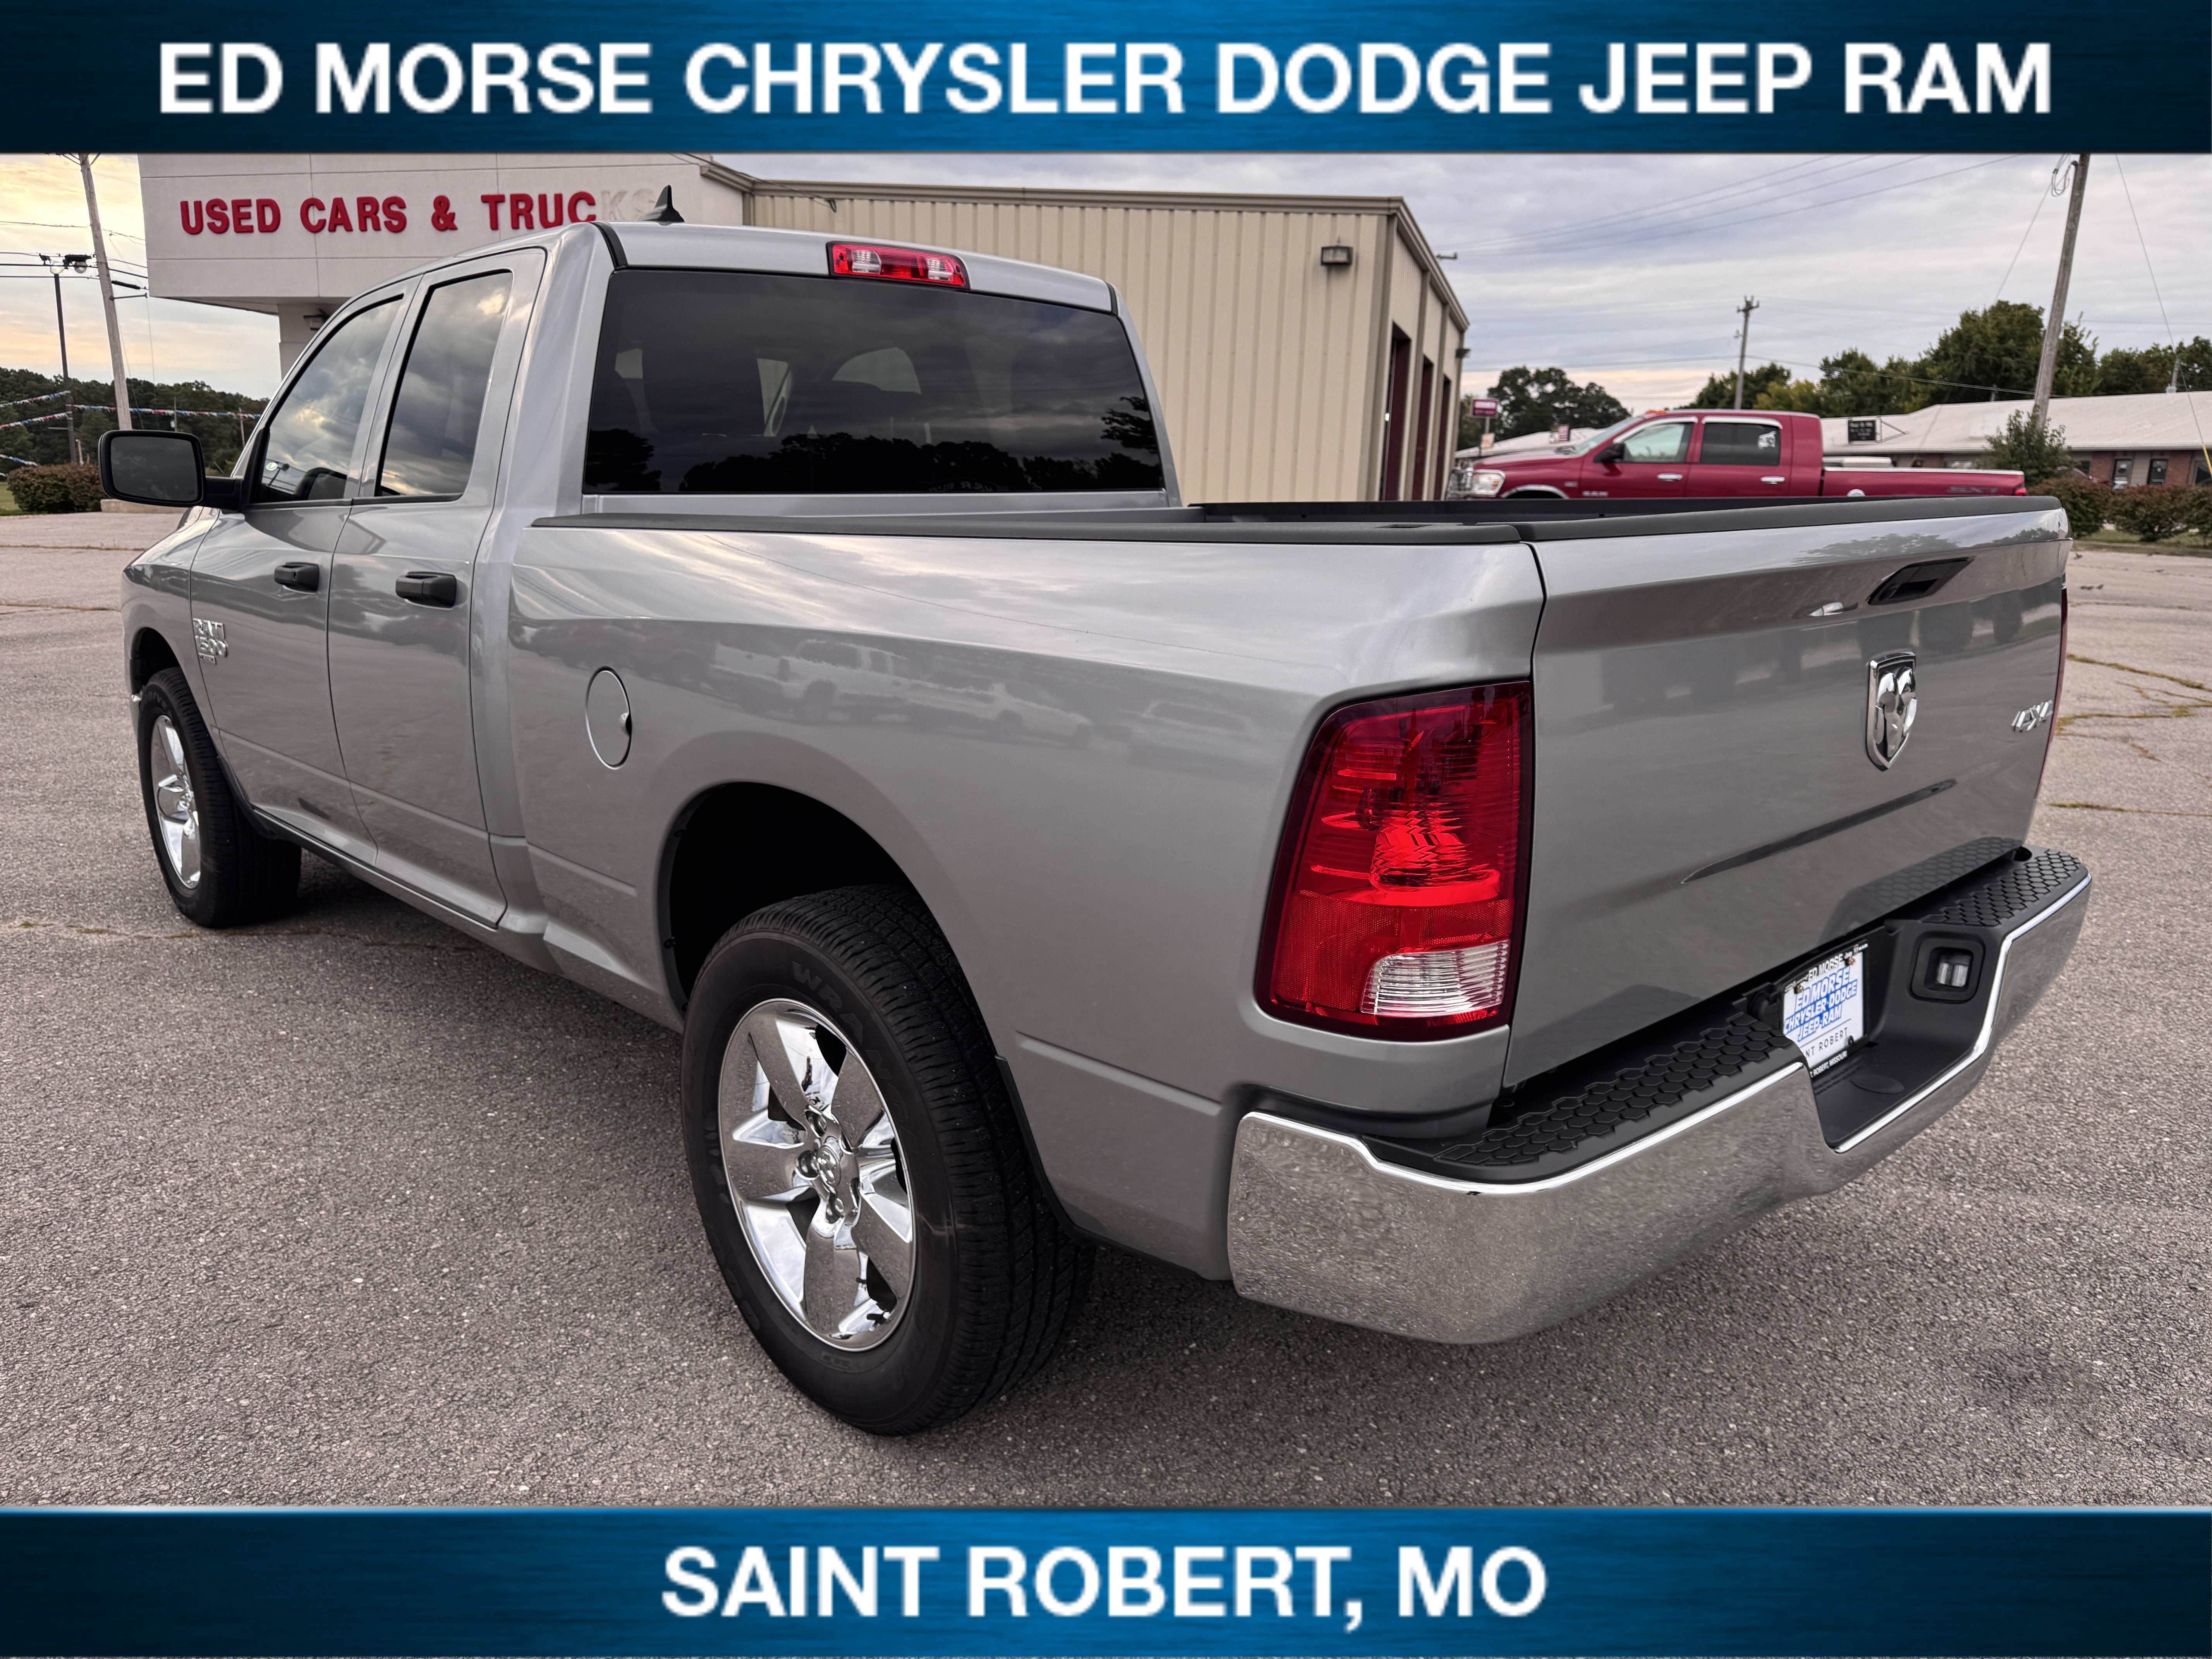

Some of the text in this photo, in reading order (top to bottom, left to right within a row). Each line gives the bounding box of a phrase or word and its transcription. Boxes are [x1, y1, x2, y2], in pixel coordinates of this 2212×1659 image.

[180, 198, 281, 235] USED
[300, 196, 407, 232] CARS
[431, 195, 458, 231] &
[1819, 953, 1843, 975] MORSE
[1795, 987, 1810, 1012] ED
[1810, 968, 1850, 1005] MORSE
[1819, 1027, 1847, 1052] ROBERT
